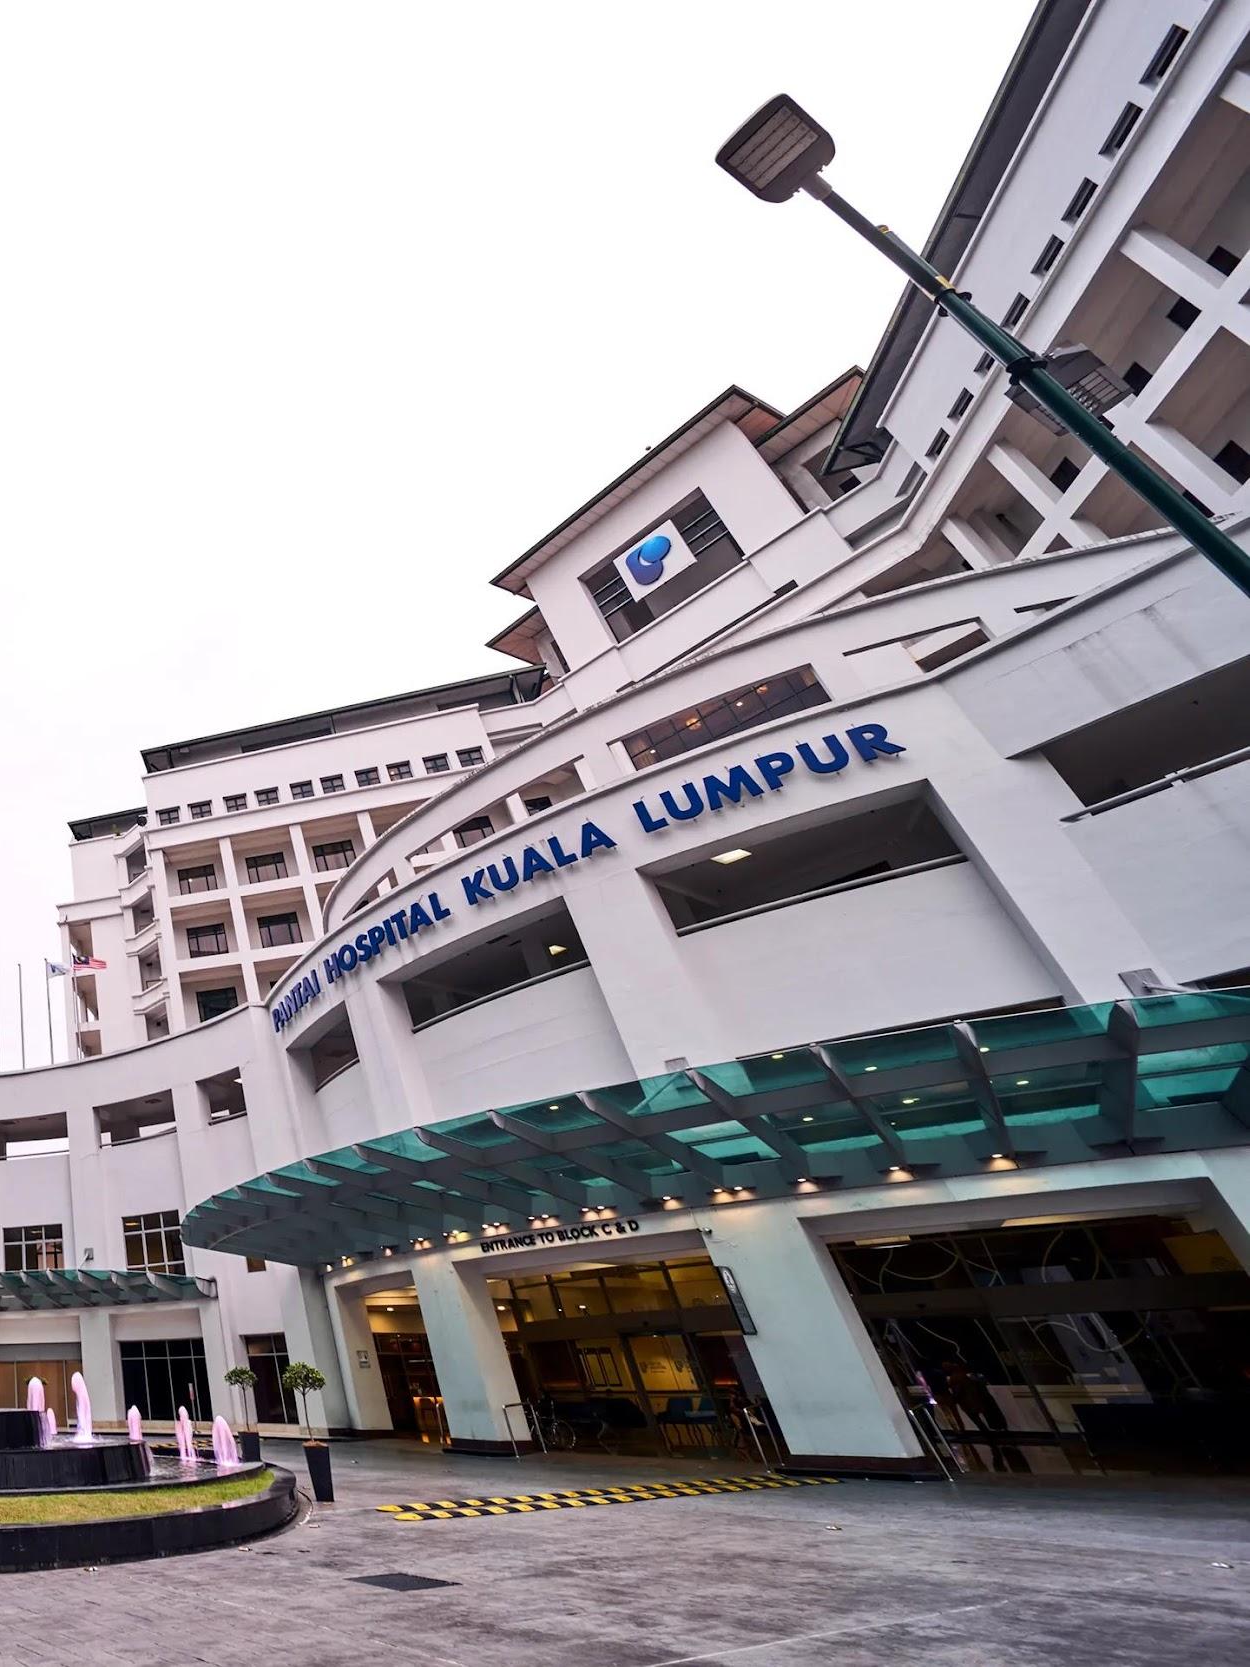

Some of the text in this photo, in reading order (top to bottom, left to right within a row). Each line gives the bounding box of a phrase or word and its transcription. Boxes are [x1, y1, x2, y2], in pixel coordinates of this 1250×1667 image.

[272, 723, 906, 1033] PANTAI HOSPITAL KUALA LUMPUR
[480, 1220, 639, 1252] ENTRANCE TO BLOCK C & D
